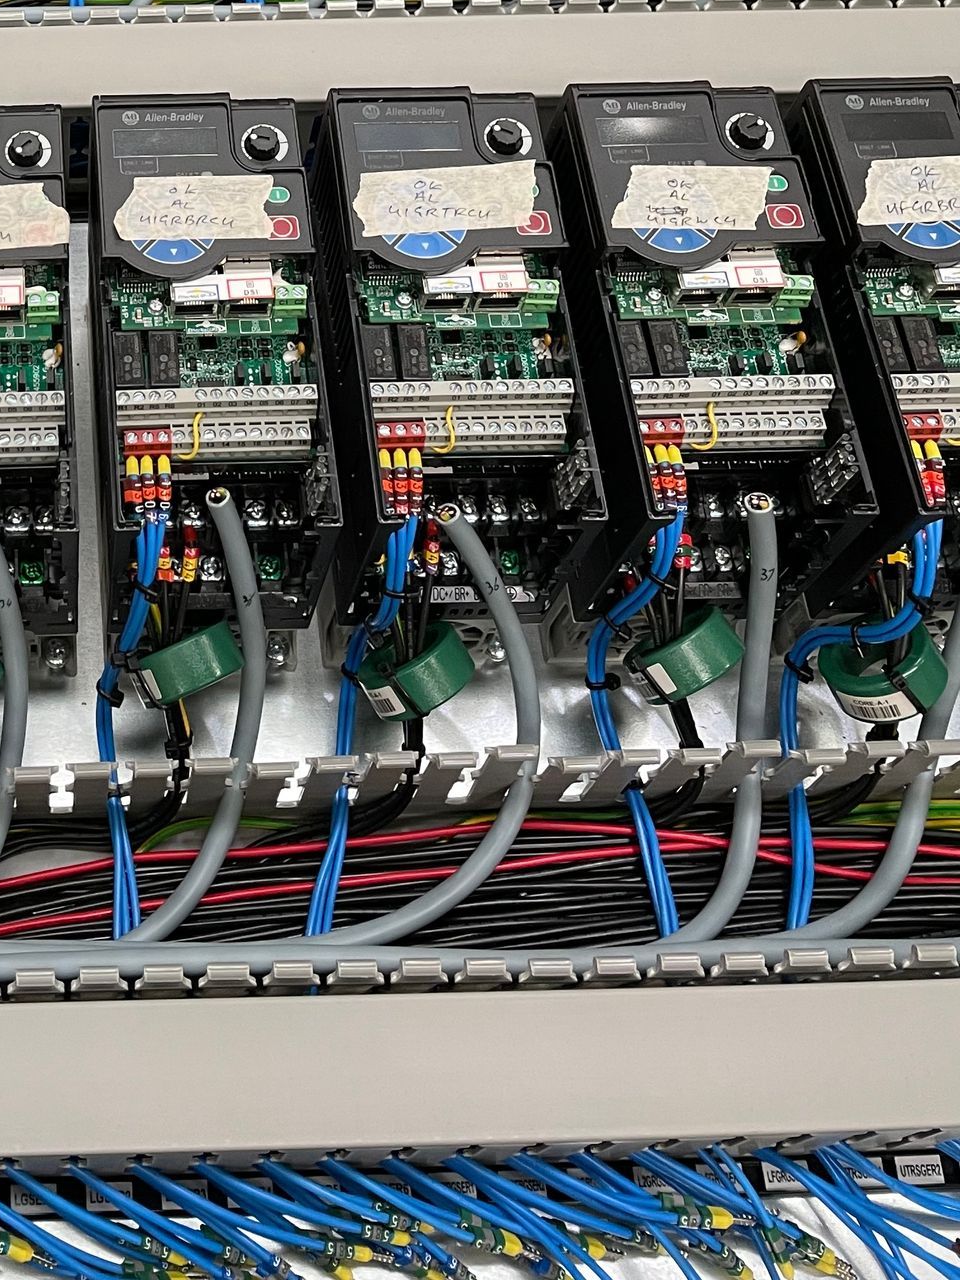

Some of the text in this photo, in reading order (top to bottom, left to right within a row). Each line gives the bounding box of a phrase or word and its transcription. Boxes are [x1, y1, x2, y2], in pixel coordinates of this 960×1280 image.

[626, 101, 687, 111] Allen-Bradley
[870, 97, 929, 107] Allen-Bradley
[385, 107, 445, 116] Allen-Bradley
[145, 113, 204, 122] Allen-Bradley
[910, 166, 940, 177] OK
[414, 181, 442, 190] OK
[667, 179, 692, 189] OK
[918, 179, 939, 192] AL
[414, 193, 438, 203] AL
[669, 190, 690, 200] AL
[171, 200, 195, 210] AL
[498, 281, 513, 289] DSI
[760, 568, 776, 581] 37
[485, 577, 500, 595] 36
[900, 1163, 942, 1177] UTRSGER2
